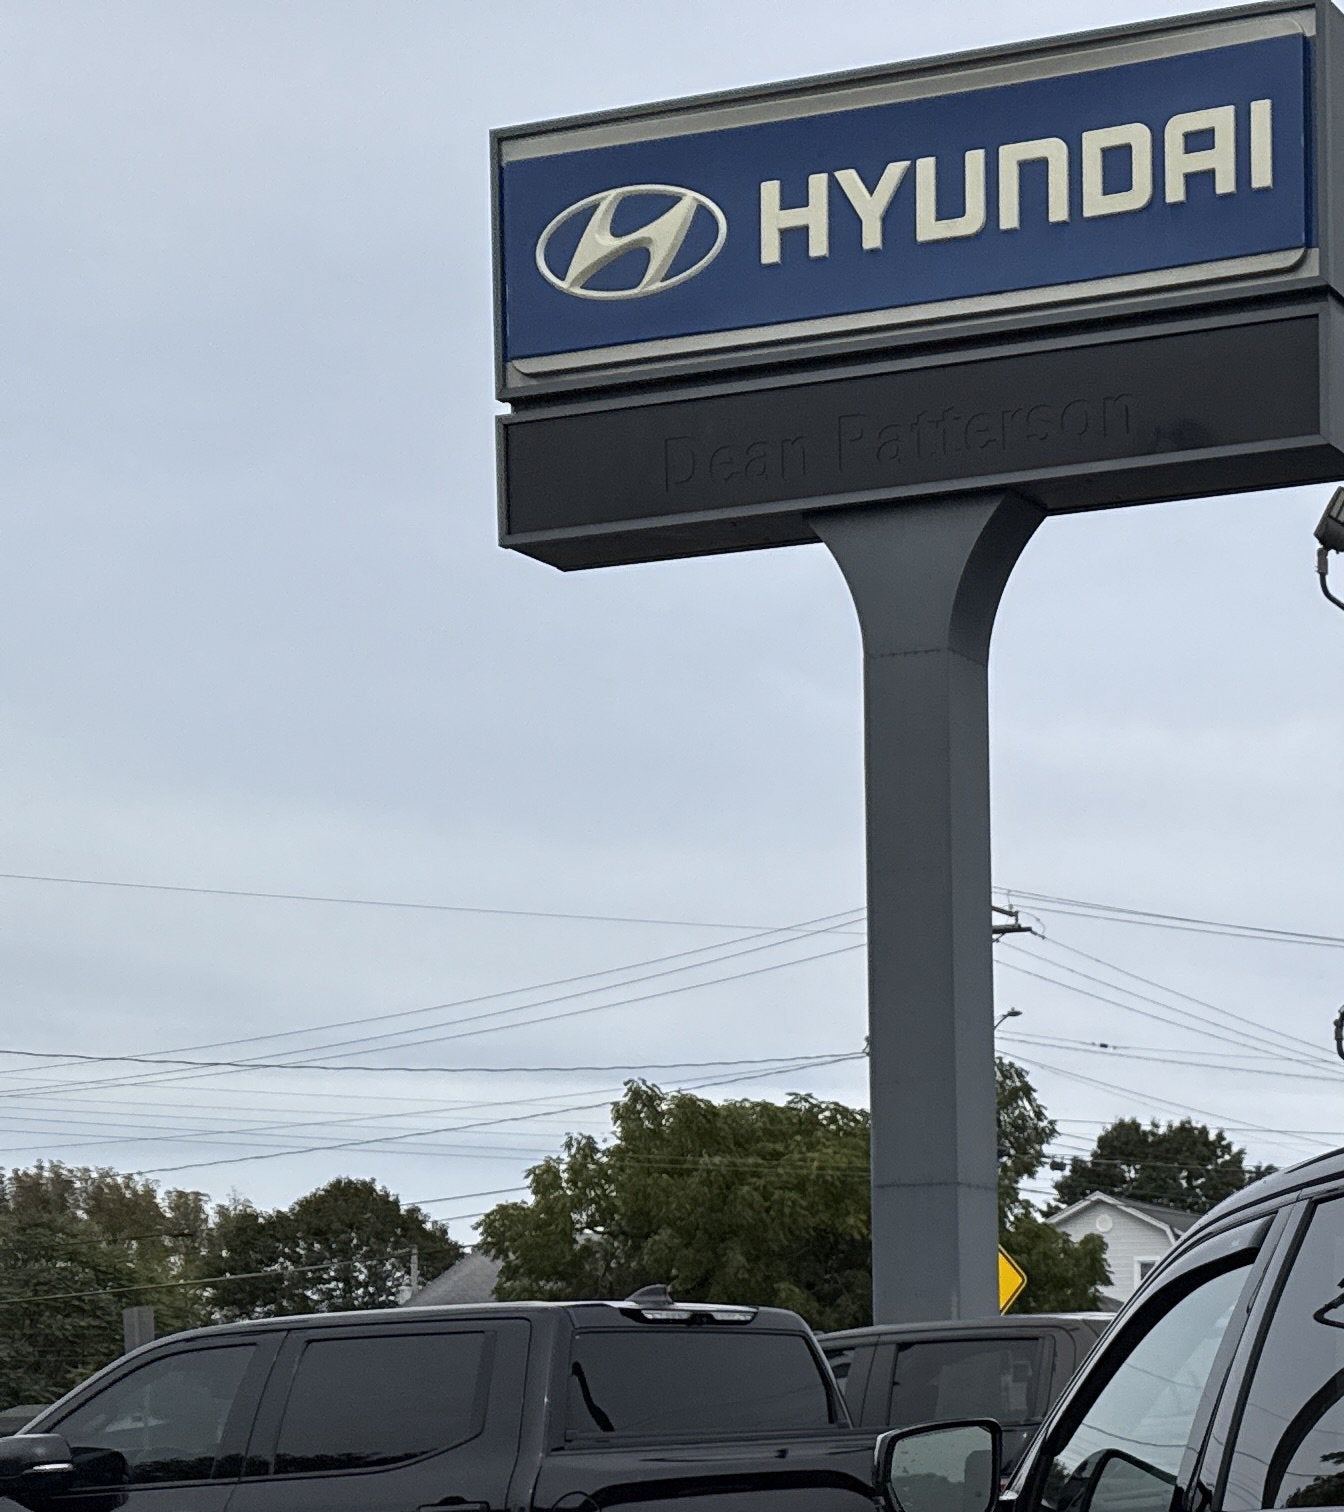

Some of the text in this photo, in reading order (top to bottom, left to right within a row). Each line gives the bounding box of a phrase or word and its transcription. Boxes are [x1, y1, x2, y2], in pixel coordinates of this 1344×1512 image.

[760, 98, 1274, 265] HYUNDAI
[664, 393, 1134, 492] Dean Patterson
